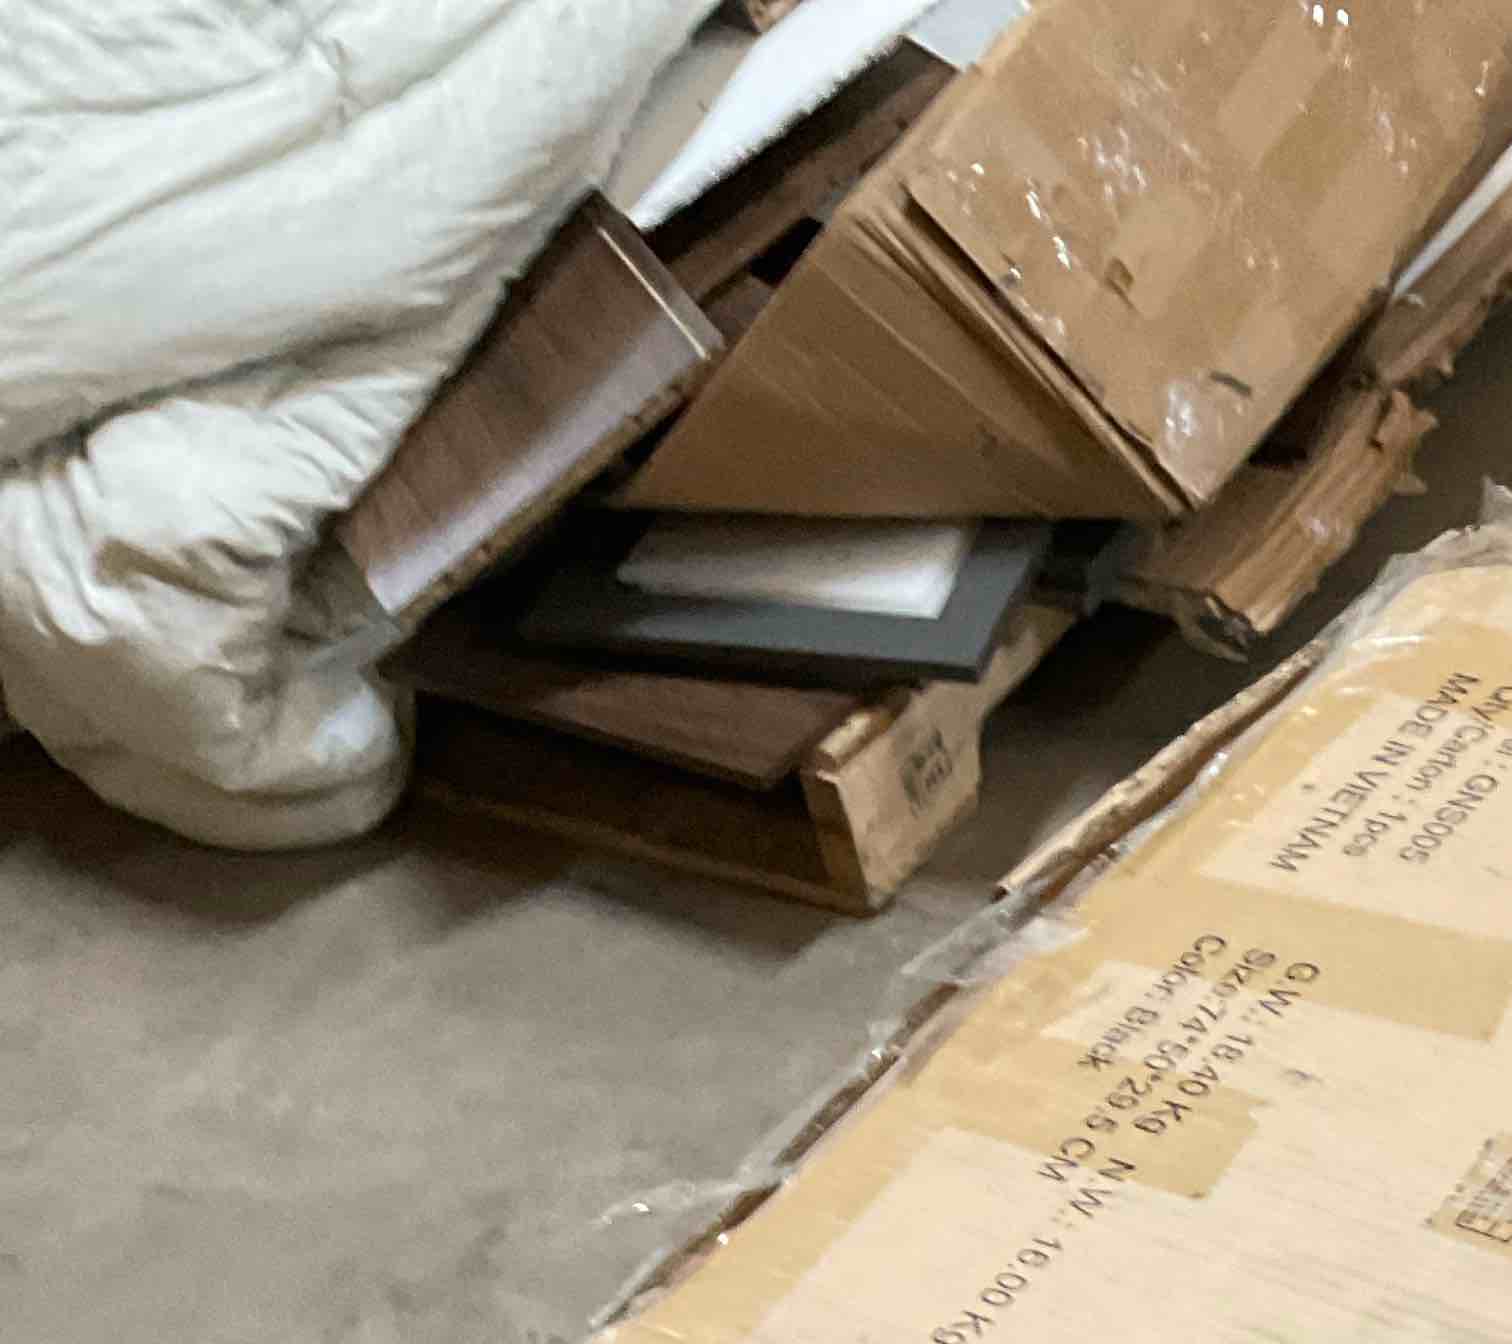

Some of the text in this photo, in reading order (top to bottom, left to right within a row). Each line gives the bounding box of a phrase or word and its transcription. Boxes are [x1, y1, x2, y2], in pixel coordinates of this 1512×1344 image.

[1271, 672, 1480, 872] MADE IN VIETNAM
[1398, 774, 1498, 864] GNS005
[1079, 1006, 1159, 1071] Black
[1178, 1033, 1253, 1097] 18.40
[1133, 1099, 1192, 1136] Kg
[1038, 1137, 1096, 1182] CM
[980, 1236, 1063, 1307] 16.00
